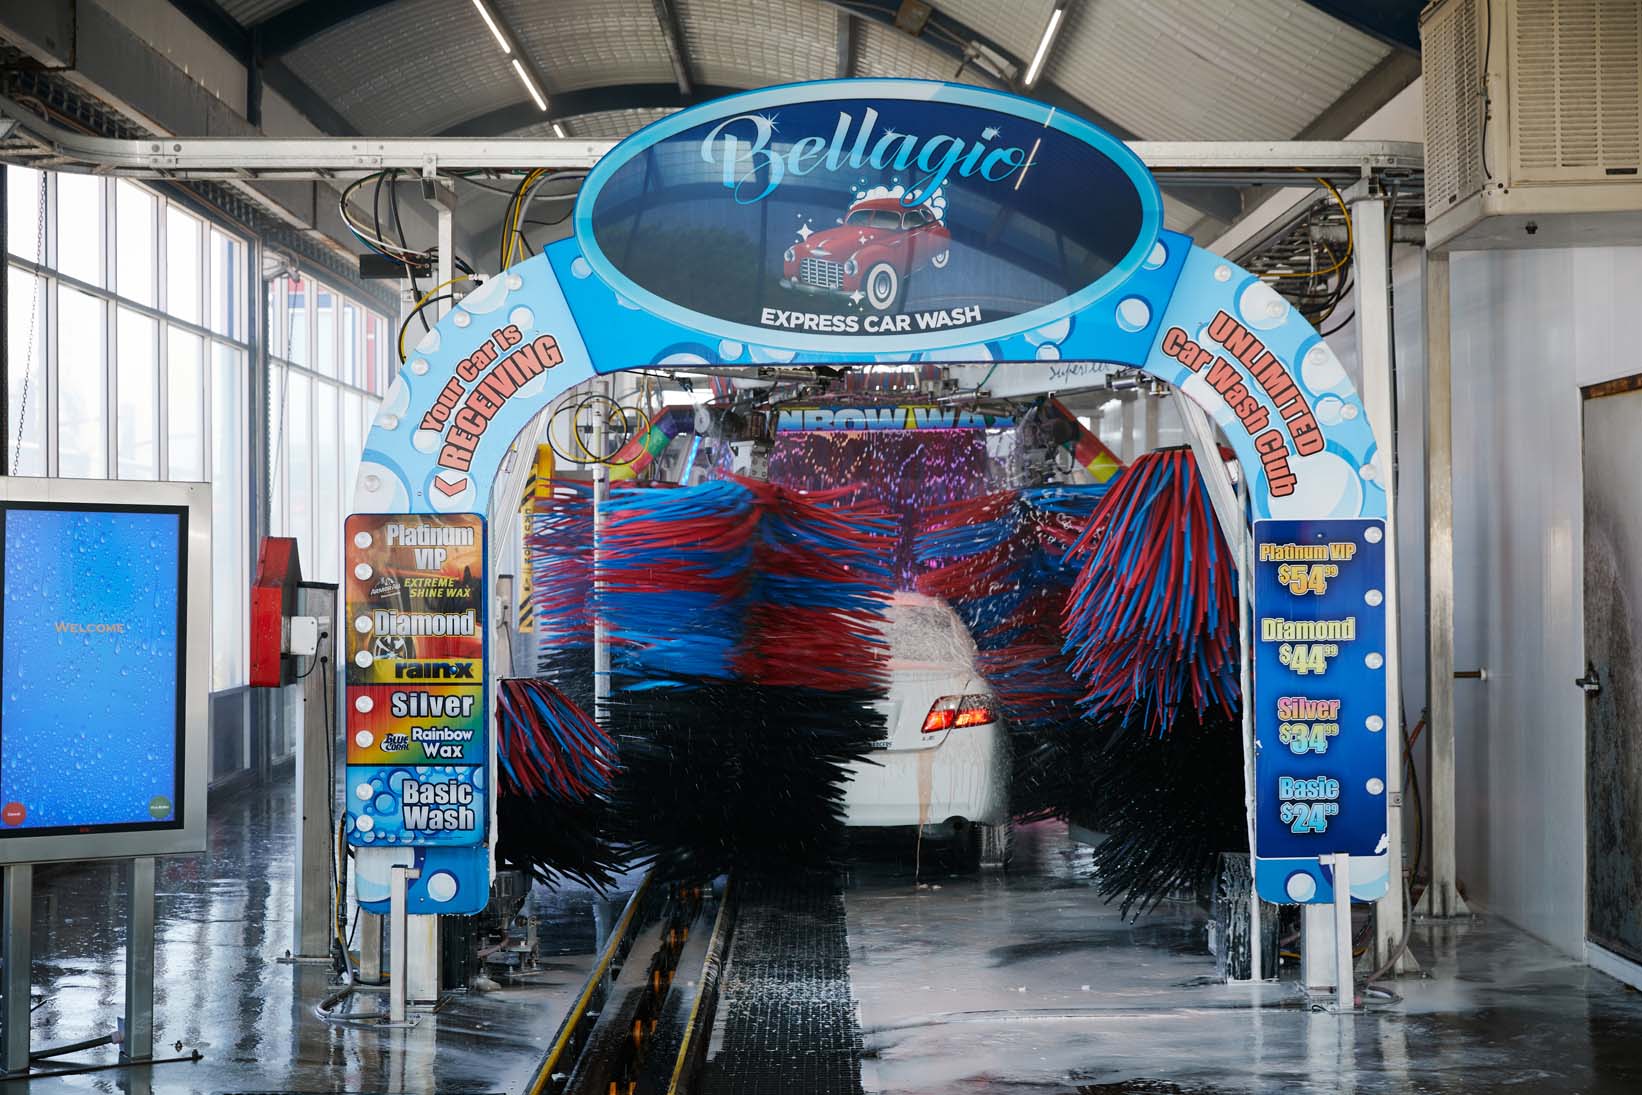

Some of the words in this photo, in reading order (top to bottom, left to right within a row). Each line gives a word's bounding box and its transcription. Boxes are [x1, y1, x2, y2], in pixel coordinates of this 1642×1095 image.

[700, 107, 1037, 208] Bellagio
[761, 308, 859, 332] EXPRESS
[864, 314, 912, 332] CAR
[915, 305, 982, 330] WASH
[420, 376, 466, 432] Your
[456, 340, 498, 383] Car
[1207, 310, 1325, 457] UNLIMITED
[438, 334, 564, 472] RECEIVING
[1162, 327, 1214, 373] Car
[1205, 356, 1270, 435] Wash
[1255, 429, 1297, 497] Club
[387, 524, 474, 547] Platinum
[414, 548, 447, 570] VIP
[1259, 543, 1329, 561] Platinum
[1329, 543, 1356, 560] VIP
[404, 578, 454, 588] EXTREME
[409, 588, 443, 598] SHINE
[445, 588, 471, 597] WAX
[374, 610, 475, 636] Diamond
[1261, 617, 1355, 641] Diamond
[391, 691, 474, 717] Silver
[1278, 697, 1340, 720] Silver
[412, 727, 473, 741] Rainbow
[422, 742, 463, 759] Wax
[403, 779, 473, 805] Basic
[1279, 776, 1339, 800] Basic
[403, 805, 474, 830] Wash
